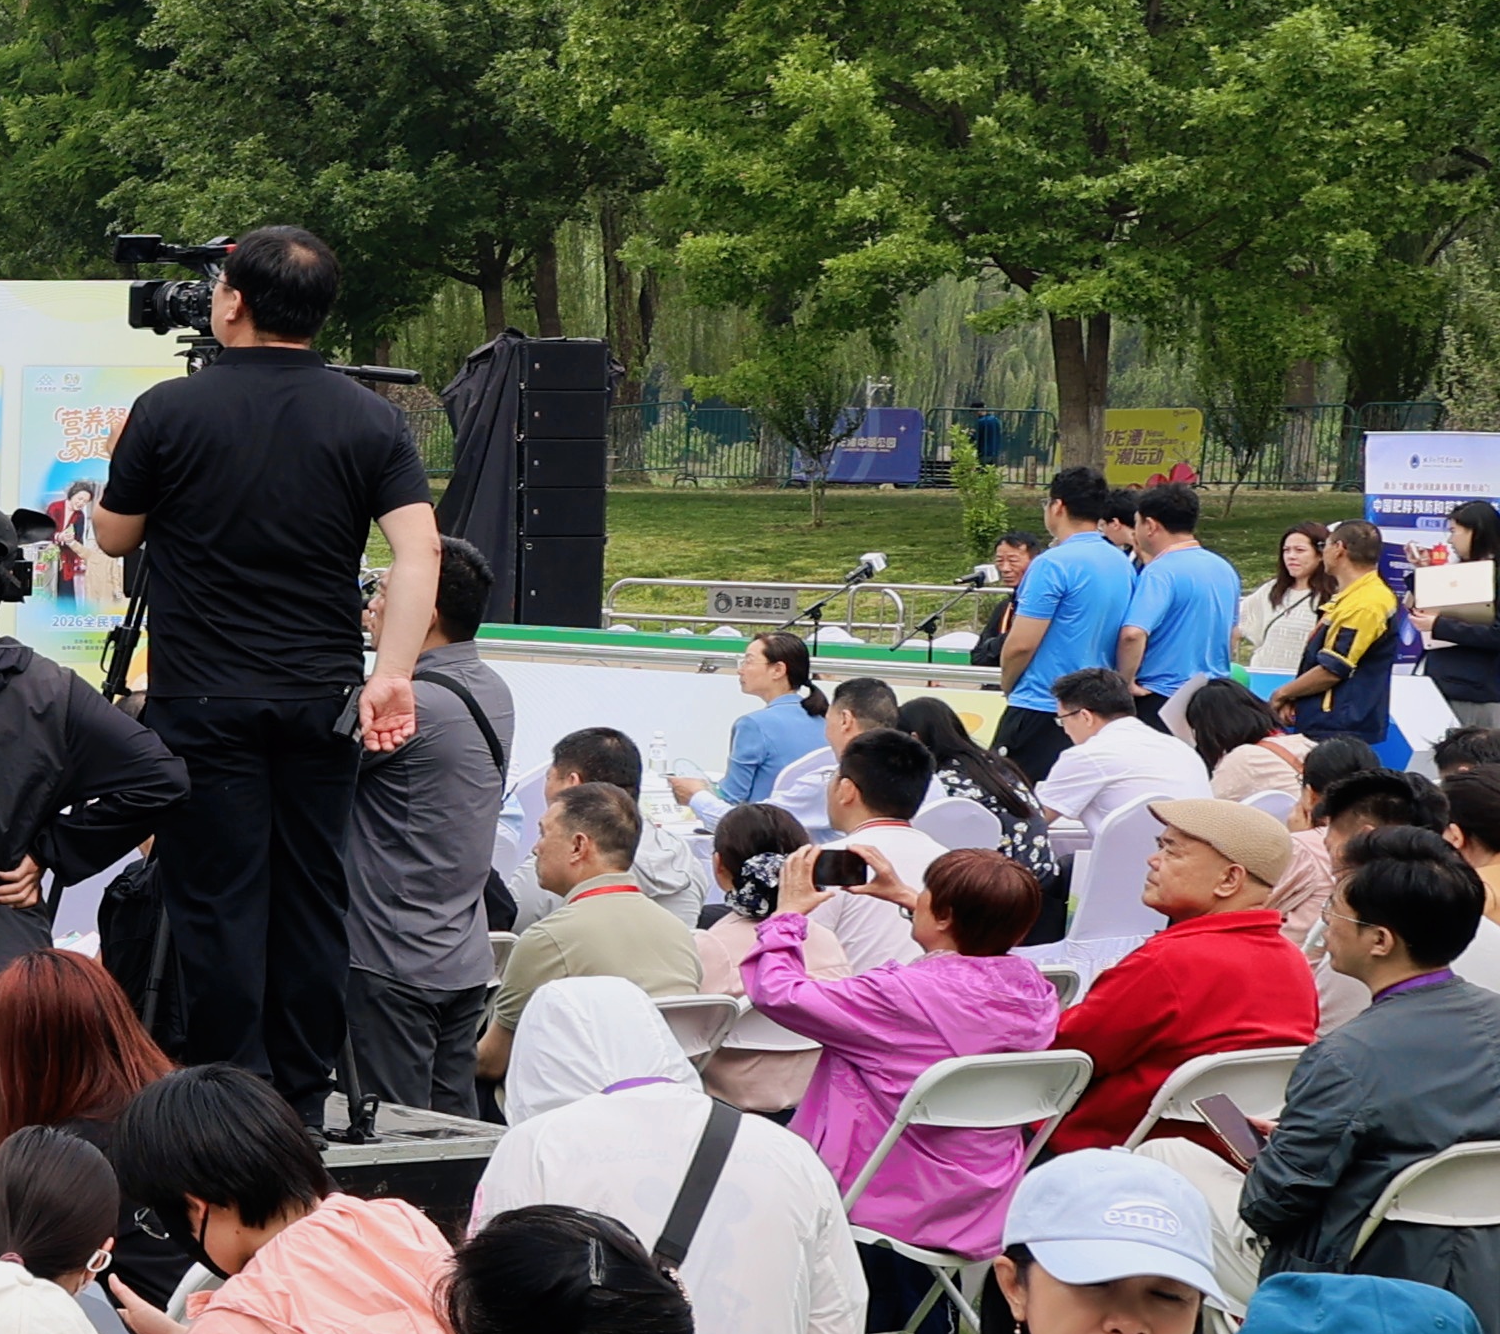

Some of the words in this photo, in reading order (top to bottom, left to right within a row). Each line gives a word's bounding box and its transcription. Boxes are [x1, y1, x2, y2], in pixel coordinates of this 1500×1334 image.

[60, 406, 129, 436] 营养餐
[58, 436, 111, 461] 家庭
[1373, 498, 1455, 515] 中国肥胖预防和控
[52, 615, 132, 627] 2026全民营
[1103, 1209, 1178, 1237] emis
